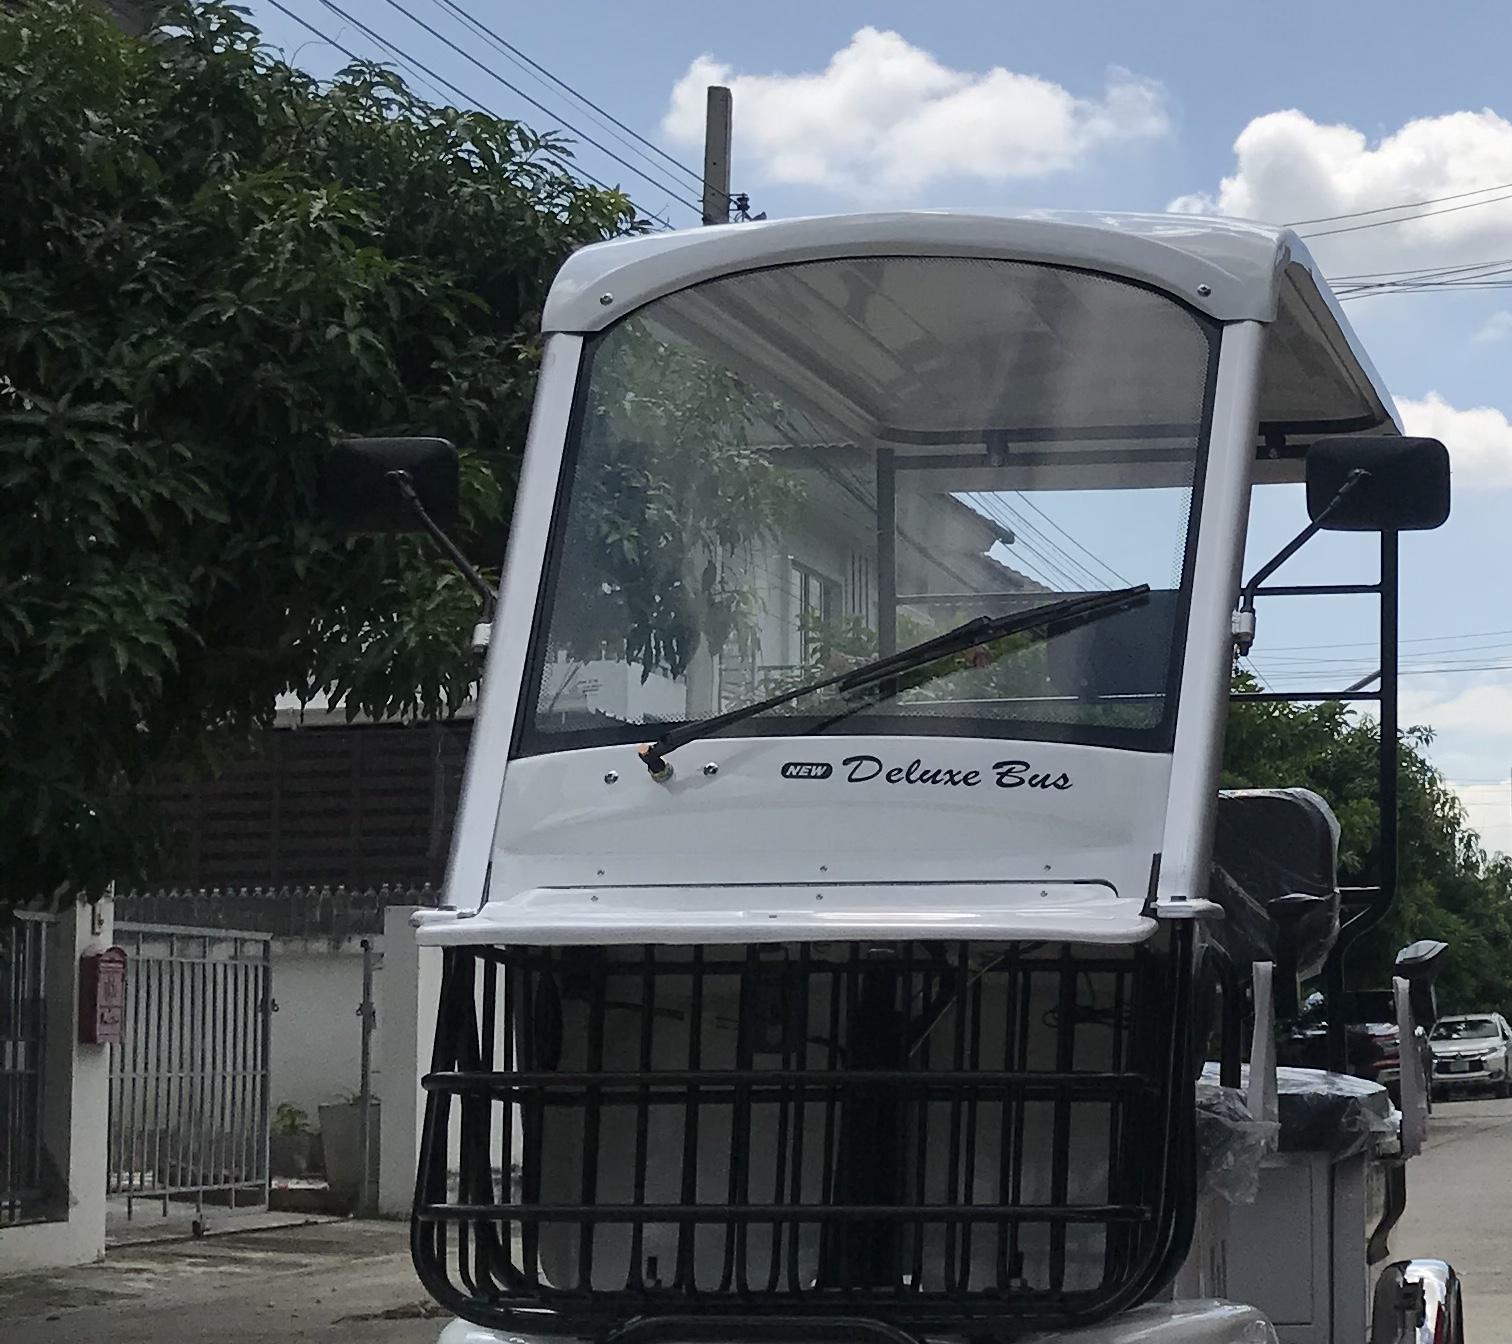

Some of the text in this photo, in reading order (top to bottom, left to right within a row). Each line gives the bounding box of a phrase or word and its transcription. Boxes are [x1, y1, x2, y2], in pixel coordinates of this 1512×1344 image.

[784, 755, 1073, 791] NEW Deluxe Bus
